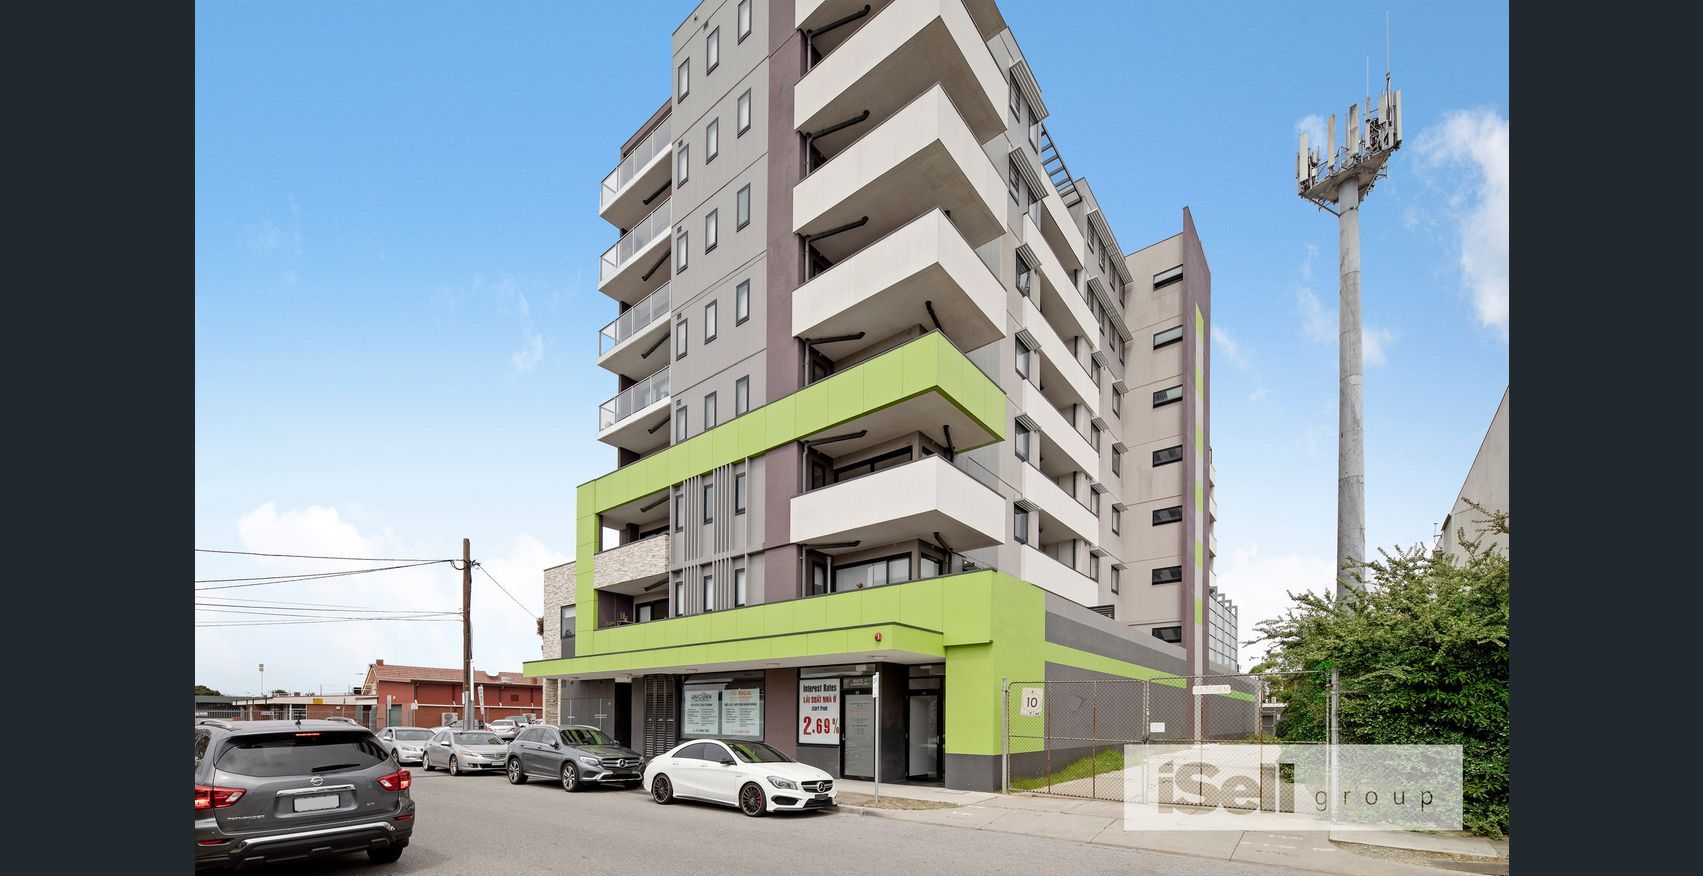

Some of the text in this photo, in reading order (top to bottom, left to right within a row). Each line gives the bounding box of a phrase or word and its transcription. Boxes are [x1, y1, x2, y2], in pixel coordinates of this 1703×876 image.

[803, 684, 837, 692] Interest Rates
[1027, 697, 1038, 708] 10
